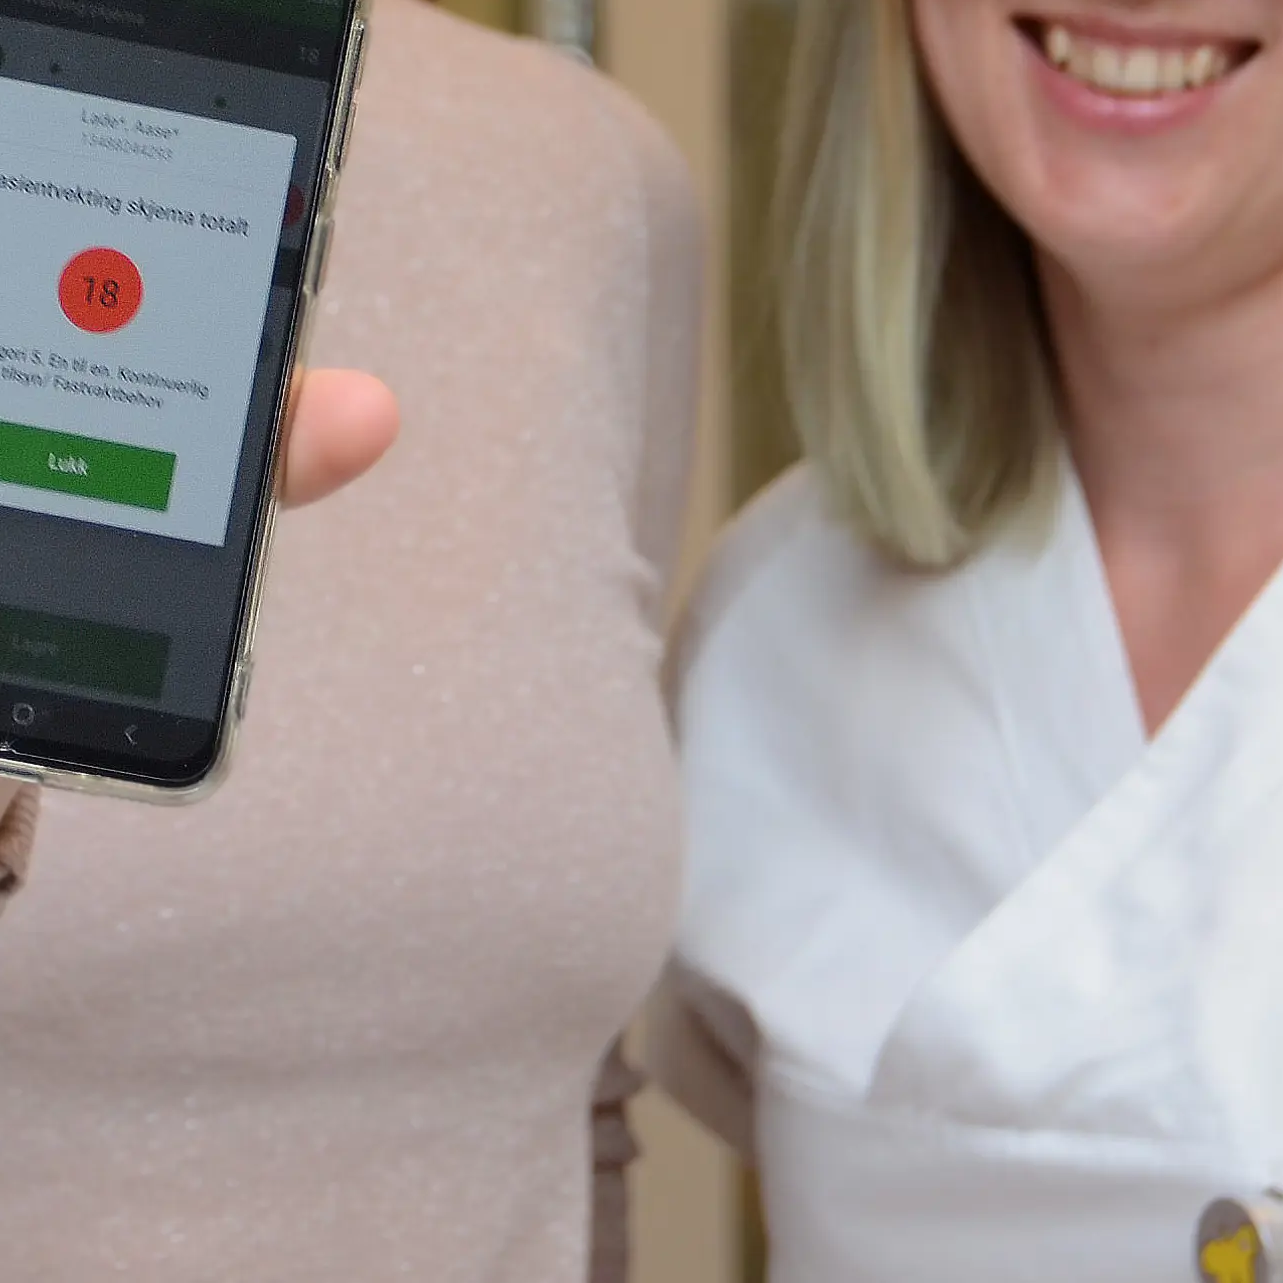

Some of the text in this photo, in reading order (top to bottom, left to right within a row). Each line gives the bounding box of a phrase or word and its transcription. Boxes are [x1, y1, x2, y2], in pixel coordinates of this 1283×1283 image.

[126, 196, 195, 224] skjema
[199, 211, 250, 237] totalt
[82, 275, 120, 308] 18
[48, 353, 70, 371] En
[71, 357, 88, 374] til
[117, 366, 209, 400] Kontinuerlig
[53, 374, 163, 409] Fastvaktbehov
[47, 452, 90, 476] Lukk
